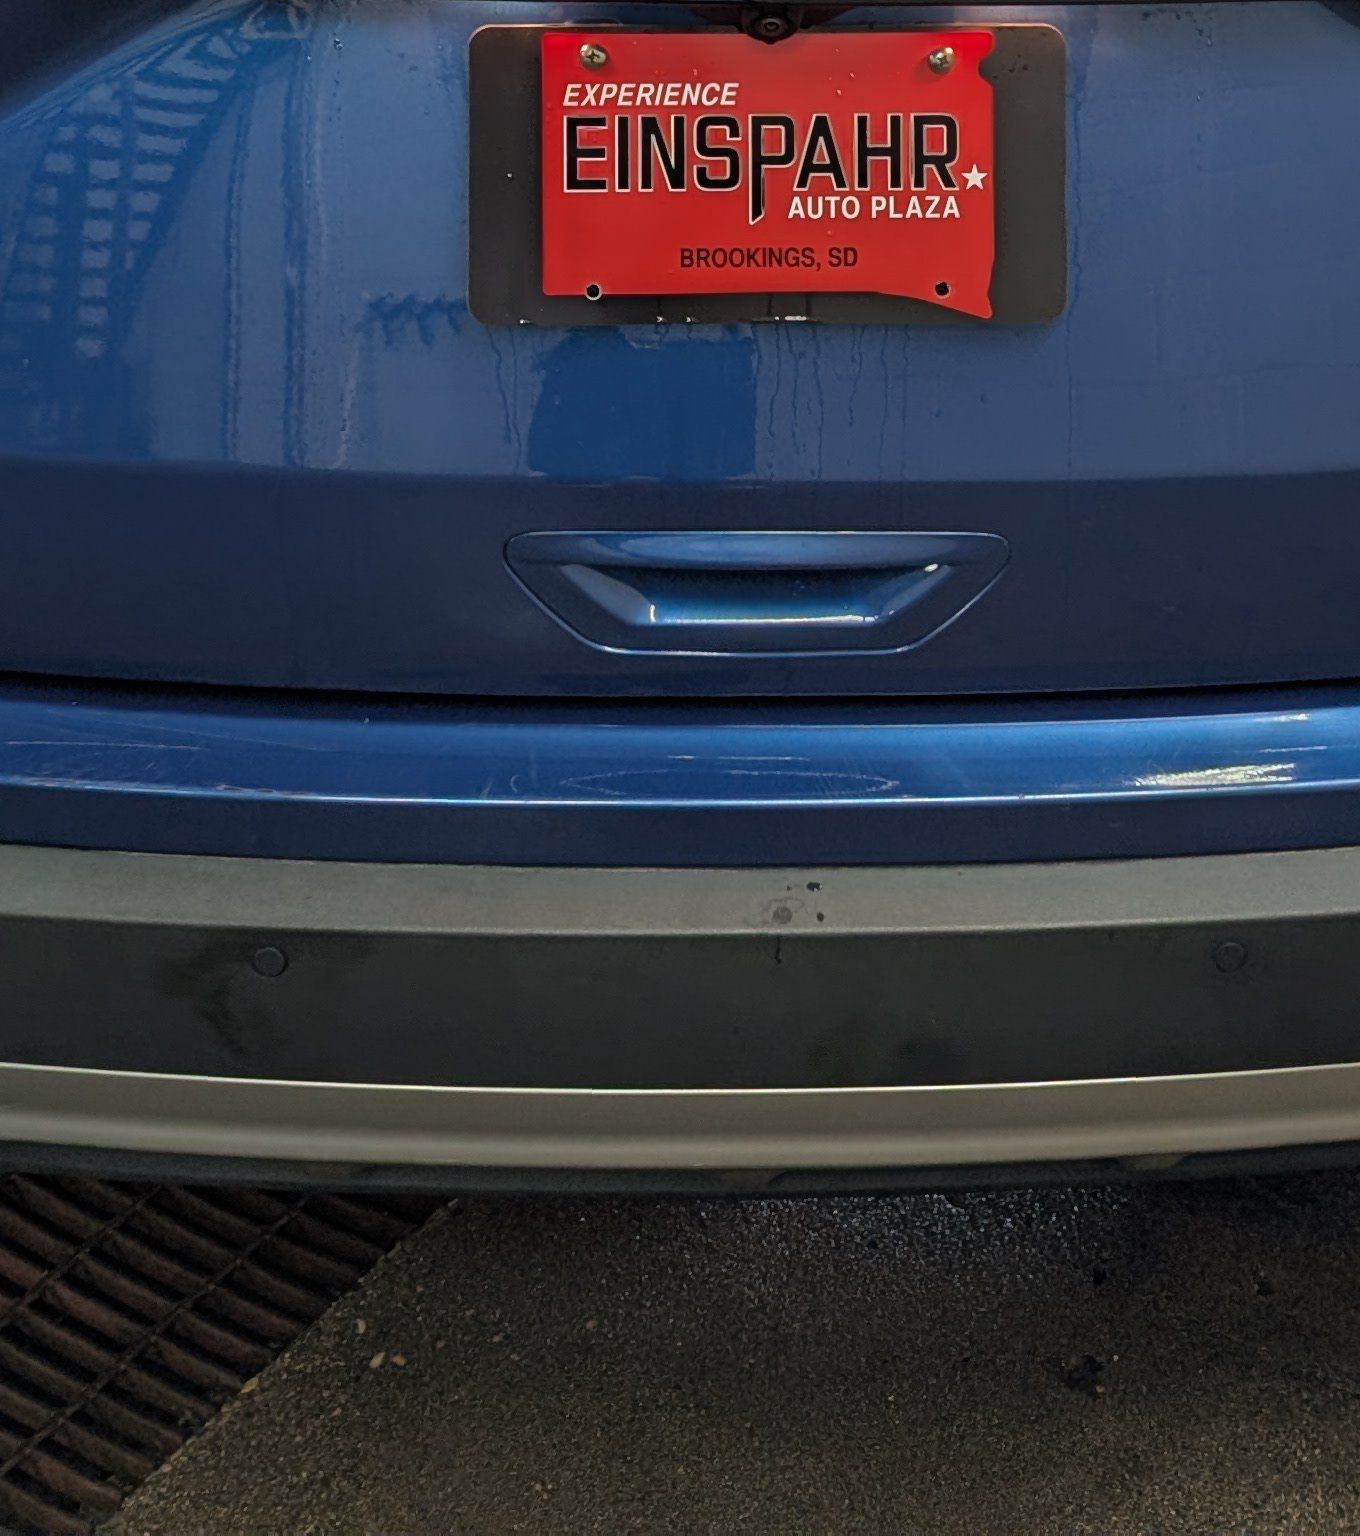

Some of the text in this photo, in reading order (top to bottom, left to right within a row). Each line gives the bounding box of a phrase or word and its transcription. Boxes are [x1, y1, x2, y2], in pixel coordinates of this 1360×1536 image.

[562, 82, 739, 107] EXPERIENCE
[562, 114, 961, 226] EINSPAHR
[787, 196, 961, 220] AUTO PLAZA
[679, 247, 859, 272] BROOKINGS, SD
